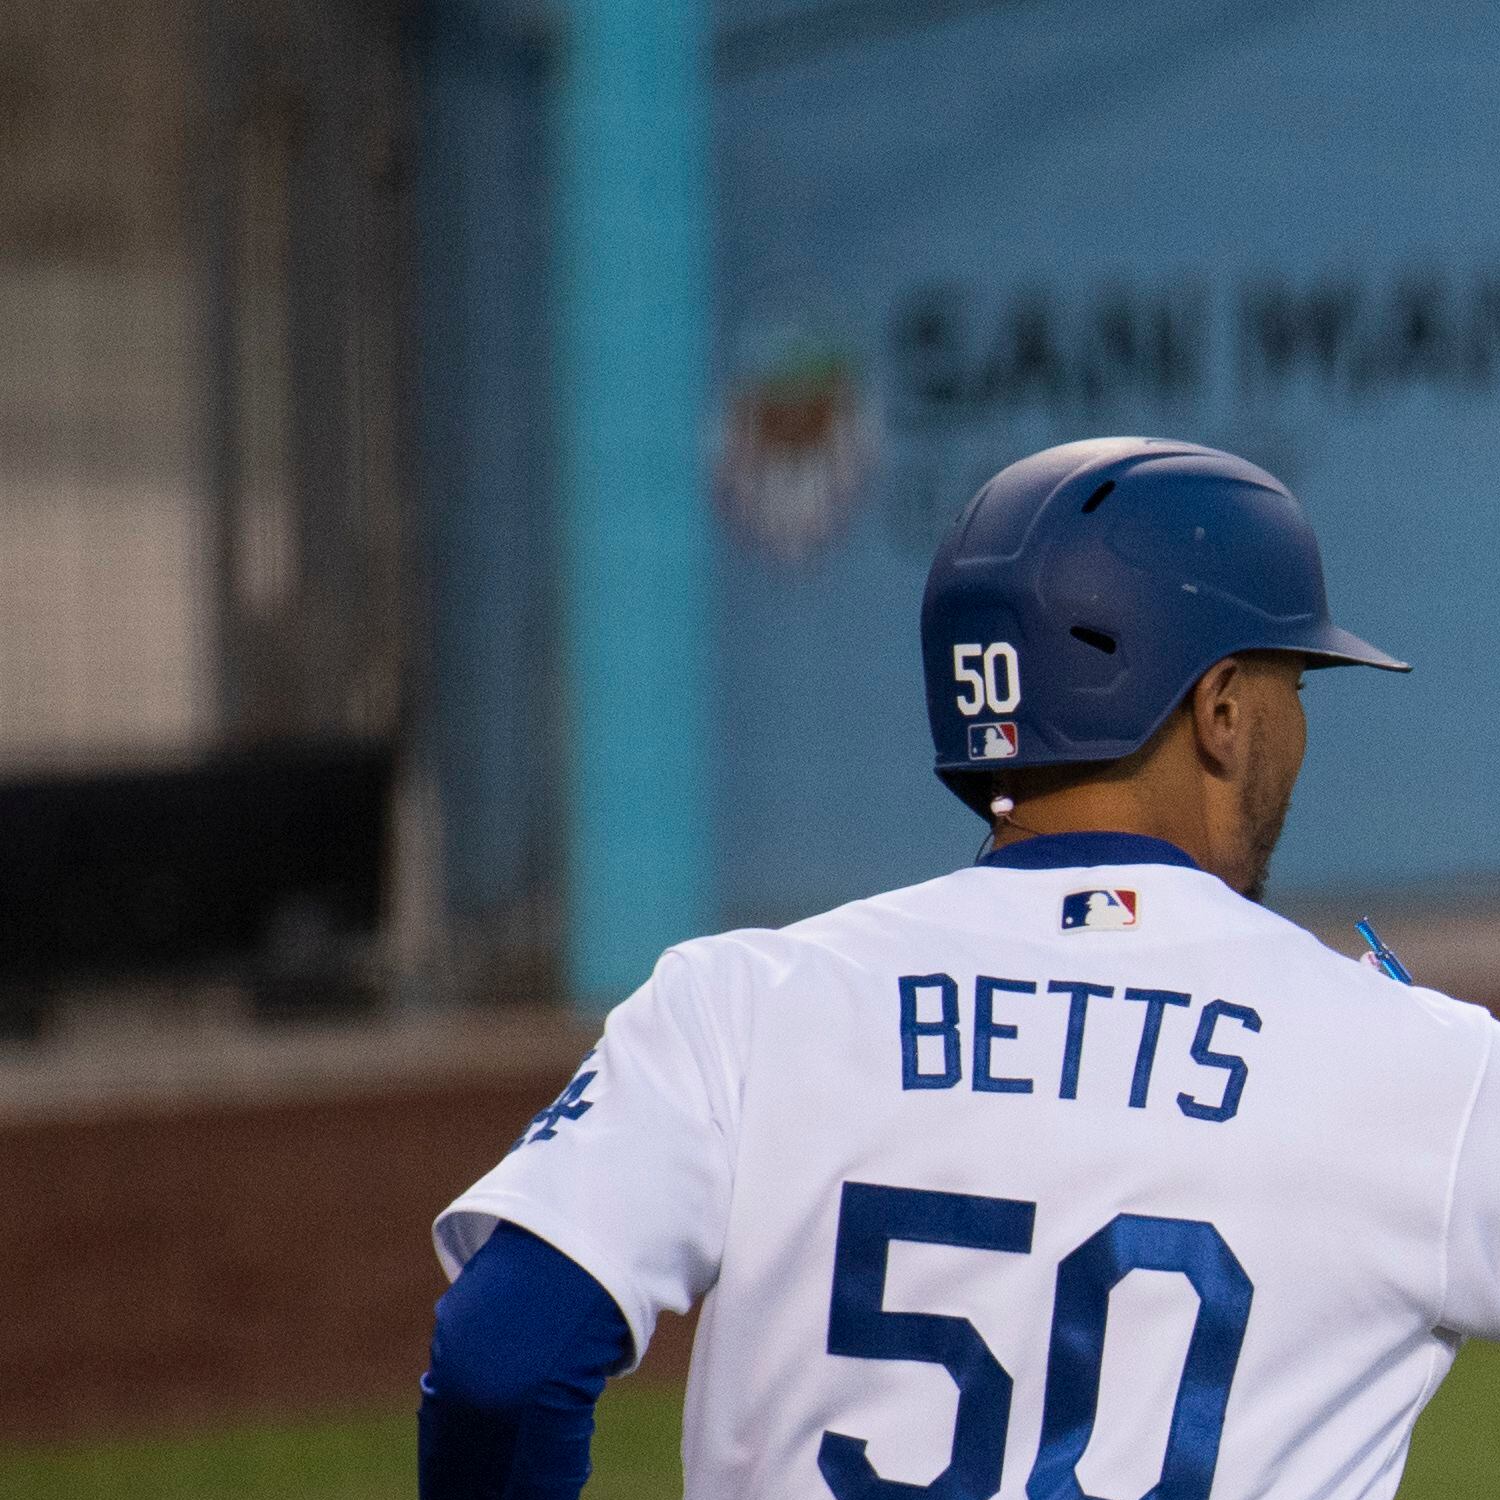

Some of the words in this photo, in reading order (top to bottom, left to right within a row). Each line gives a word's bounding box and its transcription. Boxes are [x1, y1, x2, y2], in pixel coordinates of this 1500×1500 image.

[893, 276, 1200, 416] SAN
[953, 642, 1021, 716] 50
[898, 972, 1262, 1123] BETTS
